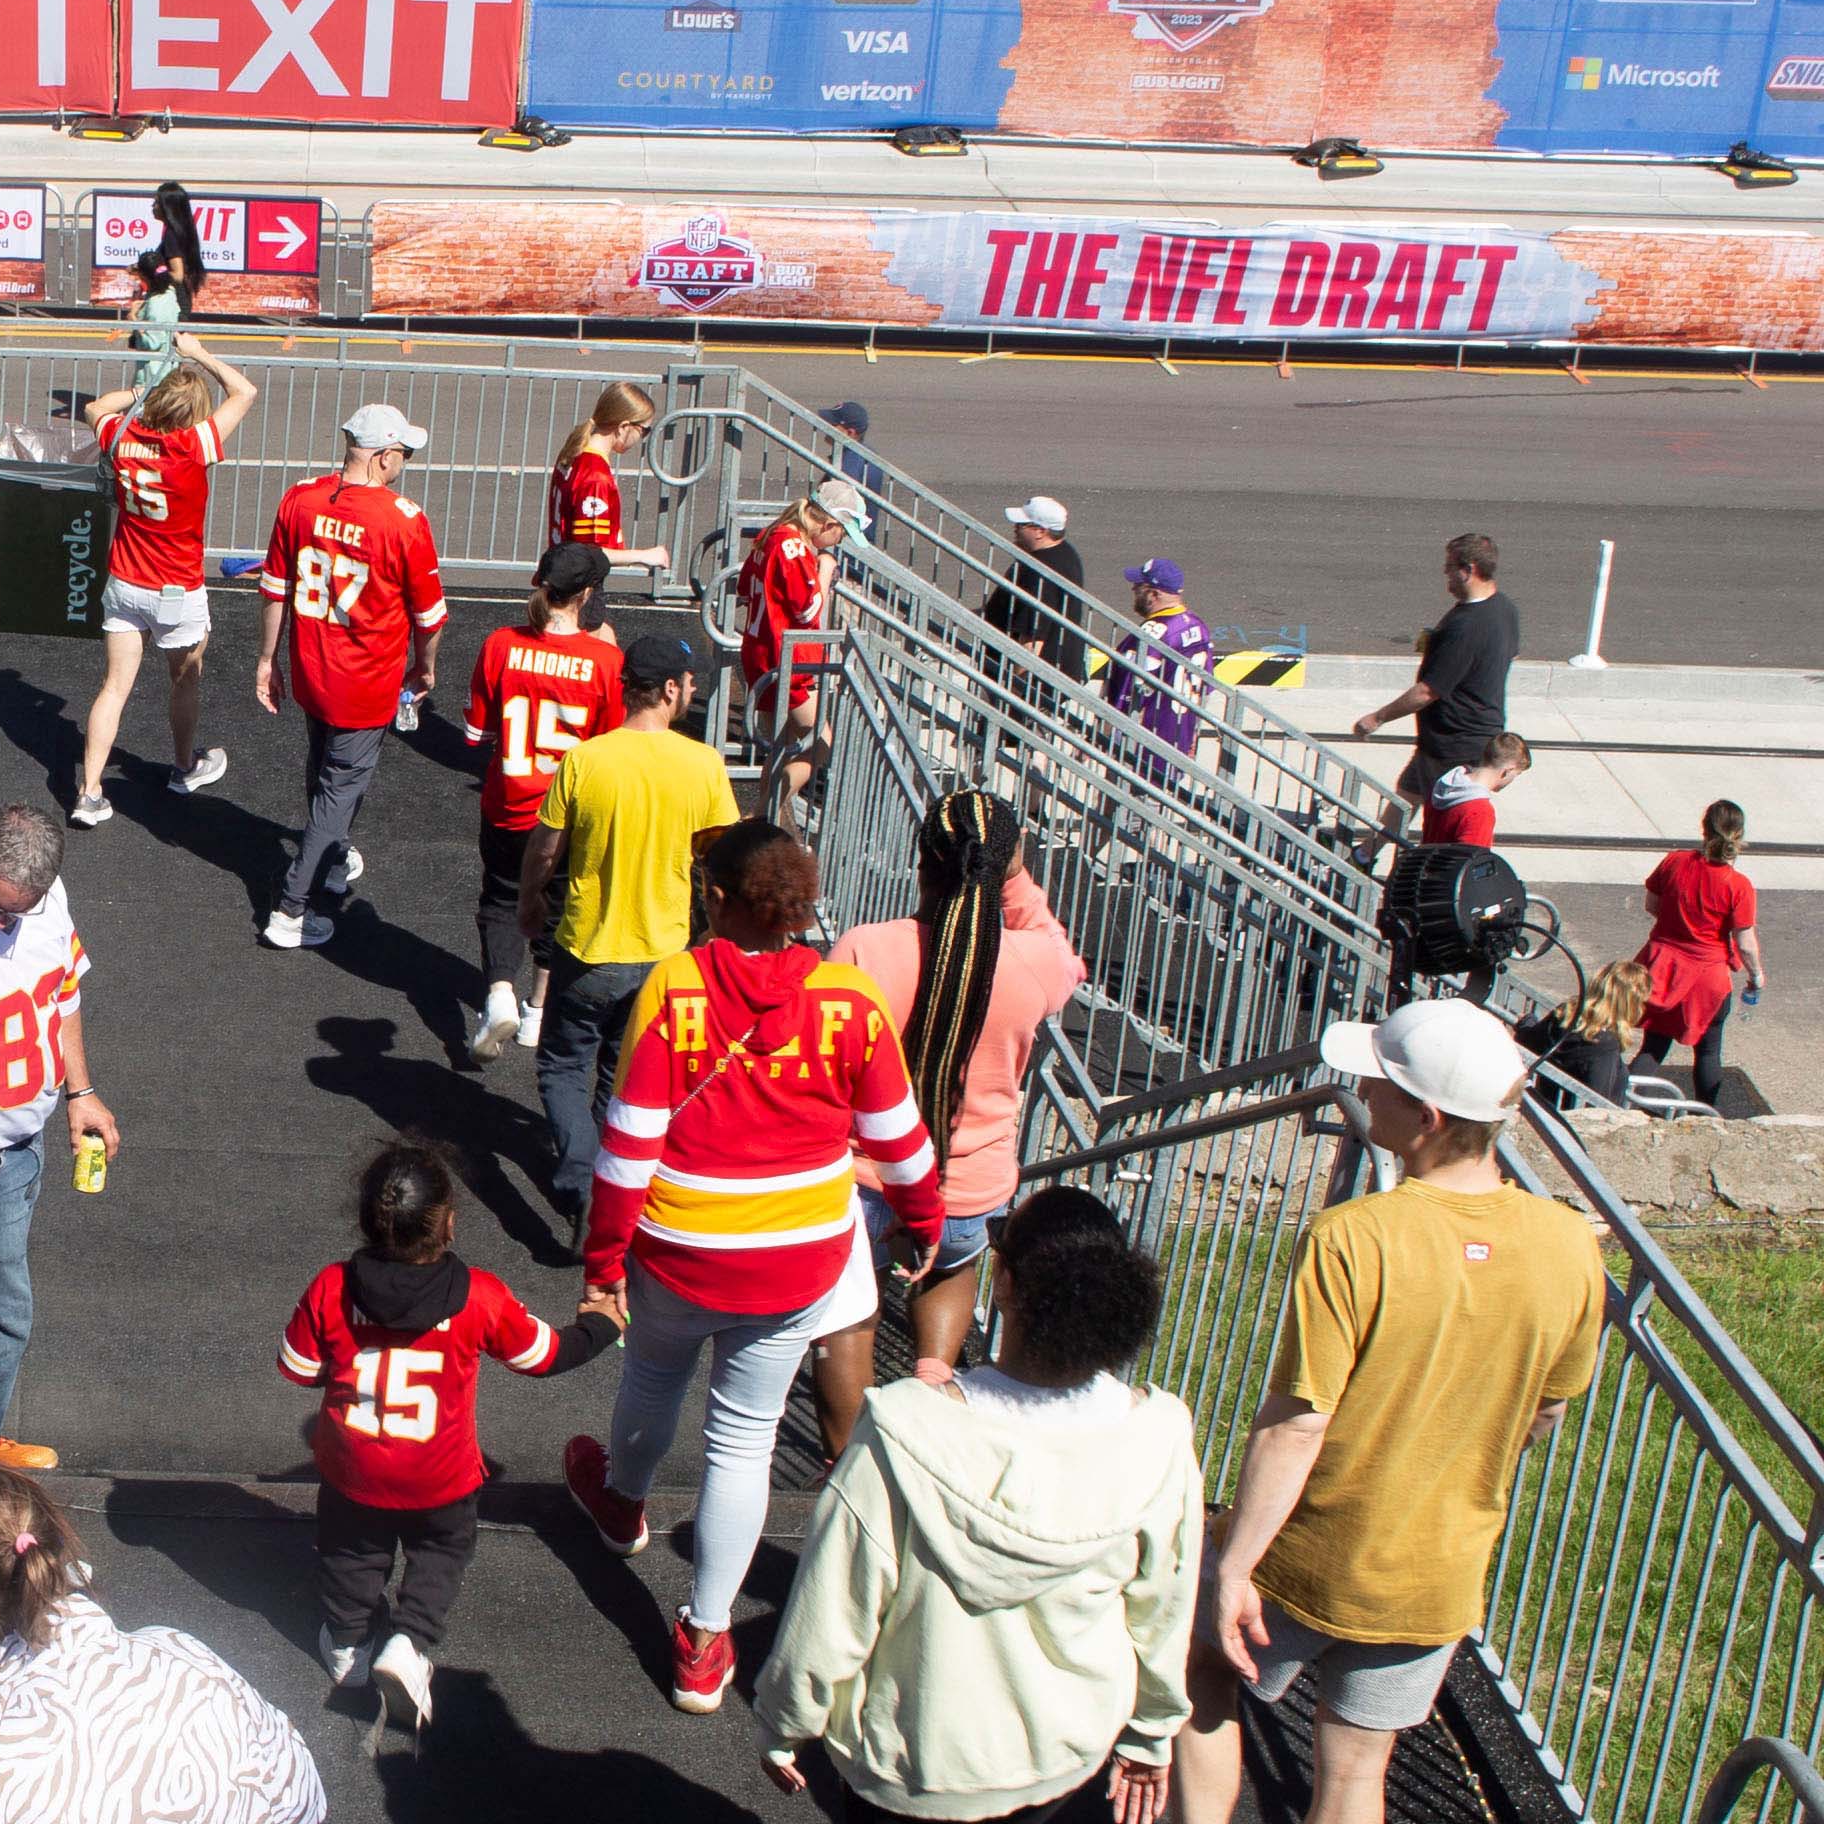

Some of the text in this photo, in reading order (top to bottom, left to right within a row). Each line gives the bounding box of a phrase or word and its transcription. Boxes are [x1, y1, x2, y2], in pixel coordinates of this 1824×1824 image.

[1171, 14, 1203, 25] 2023
[840, 31, 909, 54] VISA
[618, 72, 775, 91] COURTYARD
[1133, 75, 1222, 90] BUD LIGHT
[1607, 64, 1722, 88] Microsoft
[1777, 62, 1824, 86] SNIC
[822, 80, 914, 102] verizon
[691, 233, 713, 249] NFL
[222, 251, 236, 261] St
[652, 262, 749, 281] DRAFT
[768, 276, 813, 287] LIGHT
[776, 266, 807, 275] BUD
[979, 229, 1518, 331] THE NFL DRAFT
[118, 468, 169, 522] 15
[313, 515, 366, 548] KELCE
[62, 509, 97, 624] recycle.
[294, 545, 370, 627] 87
[507, 647, 595, 682] MAHOMES
[501, 694, 590, 778] 15
[344, 1347, 445, 1444] 15
